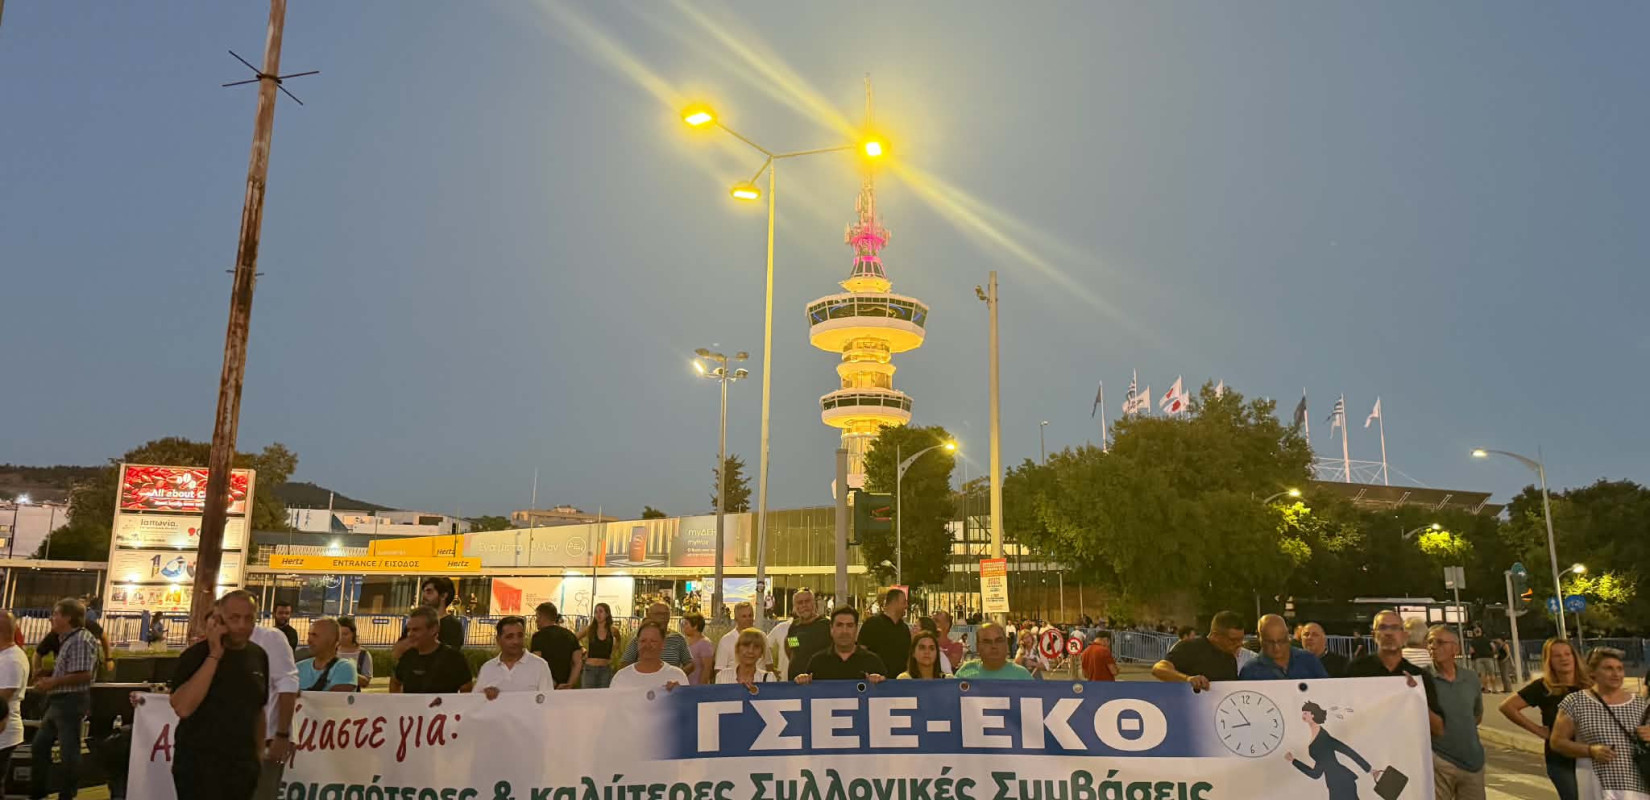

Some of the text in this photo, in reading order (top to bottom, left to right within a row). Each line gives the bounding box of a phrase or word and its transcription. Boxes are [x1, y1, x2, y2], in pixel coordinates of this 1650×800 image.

[166, 489, 195, 499] about
[436, 548, 456, 556] Hertz
[281, 557, 305, 565] Hertz
[332, 559, 377, 567] ENTRANCE
[384, 560, 420, 568] ΕΙΣΟΔΟΣ
[447, 560, 470, 568] Hertz
[1241, 695, 1250, 705] 12
[697, 696, 1168, 753] ΓΣΕΕ-ΕΚΘ
[1273, 719, 1279, 728] 3
[1250, 744, 1255, 754] 6
